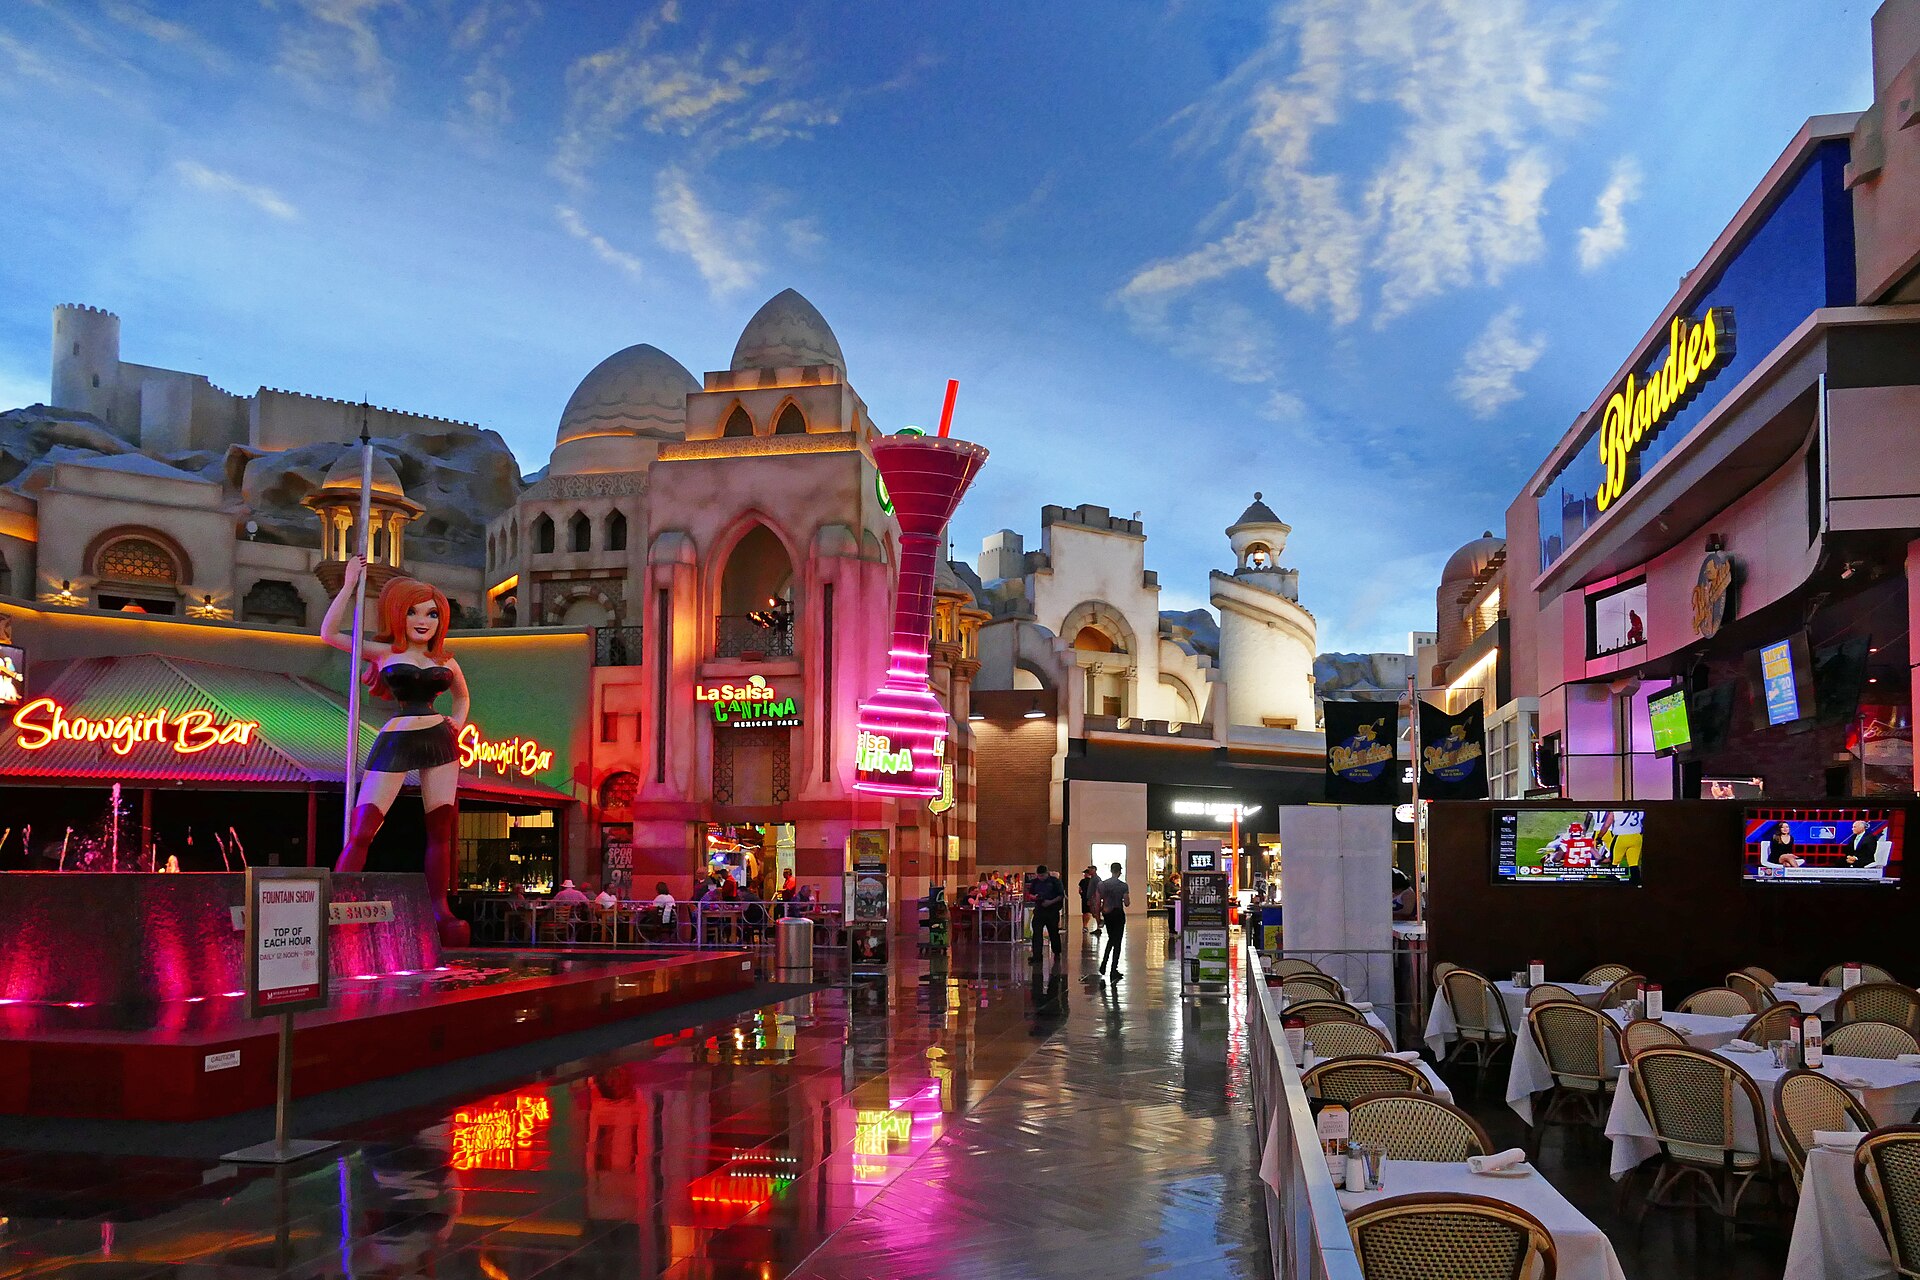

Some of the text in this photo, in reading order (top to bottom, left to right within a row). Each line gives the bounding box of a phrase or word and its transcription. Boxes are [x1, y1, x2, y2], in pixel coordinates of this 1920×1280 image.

[1597, 307, 1717, 512] Blondies
[1763, 644, 1788, 663] HAPPY
[714, 697, 797, 722] CANTINA
[12, 698, 260, 755] Showgirl Bar
[857, 730, 889, 751] alsa
[457, 723, 554, 776] Showgirl Bar
[857, 748, 912, 772] NTINA
[1620, 810, 1640, 827] 73
[608, 847, 633, 857] SPOR
[1567, 847, 1591, 865] 55
[608, 855, 633, 865] EVEN
[1189, 876, 1210, 886] KEEP
[262, 890, 315, 904] FOUNTAIN SHOW
[1189, 886, 1217, 896] VEGAS
[1189, 895, 1221, 904] STRONG
[346, 906, 387, 920] SHOPS
[273, 927, 303, 937] TOP OF
[264, 936, 312, 948] EACH HOUR
[260, 953, 275, 961] DAILY
